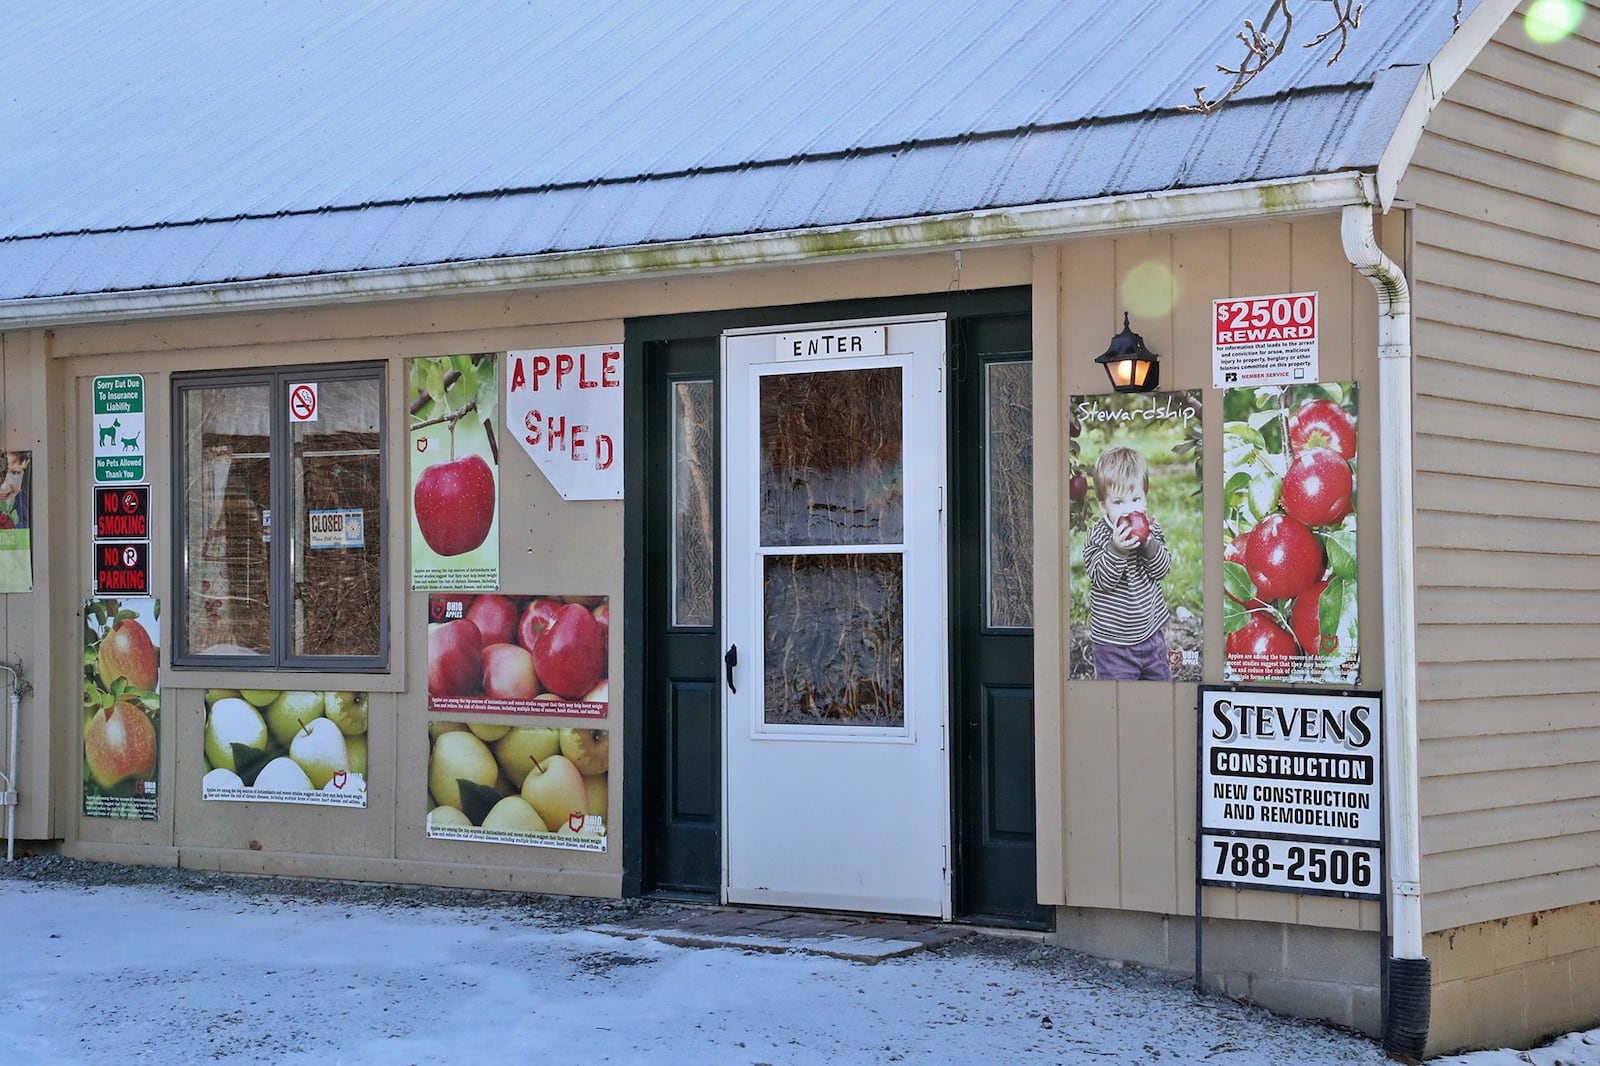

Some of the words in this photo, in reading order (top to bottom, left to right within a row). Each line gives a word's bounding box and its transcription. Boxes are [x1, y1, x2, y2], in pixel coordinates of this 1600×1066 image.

[1218, 298, 1313, 328] $2500
[1218, 326, 1312, 342] REWARD
[793, 334, 864, 357] ENTER
[511, 351, 621, 393] APPLE
[97, 381, 113, 390] Sorry
[115, 380, 126, 388] But
[128, 380, 140, 388] Due
[99, 392, 106, 400] To
[108, 392, 138, 400] Insurance
[106, 402, 131, 412] Liability
[1078, 396, 1196, 428] Stewardship
[524, 409, 614, 471] SHED
[106, 459, 118, 467] Pets
[120, 458, 142, 466] Allowed
[104, 493, 118, 512] NO
[98, 516, 145, 535] SMOKING
[312, 514, 344, 533] CLOSED
[104, 548, 118, 566] NO
[98, 570, 144, 589] PARKING
[1212, 700, 1371, 747] STEVENS
[1216, 752, 1366, 780] CONSTRUCTION
[1214, 783, 1248, 800] NEW
[1253, 786, 1370, 810] CONSTRUCTION
[1224, 804, 1254, 821] AND
[1260, 806, 1360, 829] REMODELING
[1214, 841, 1370, 886] 788-2506
